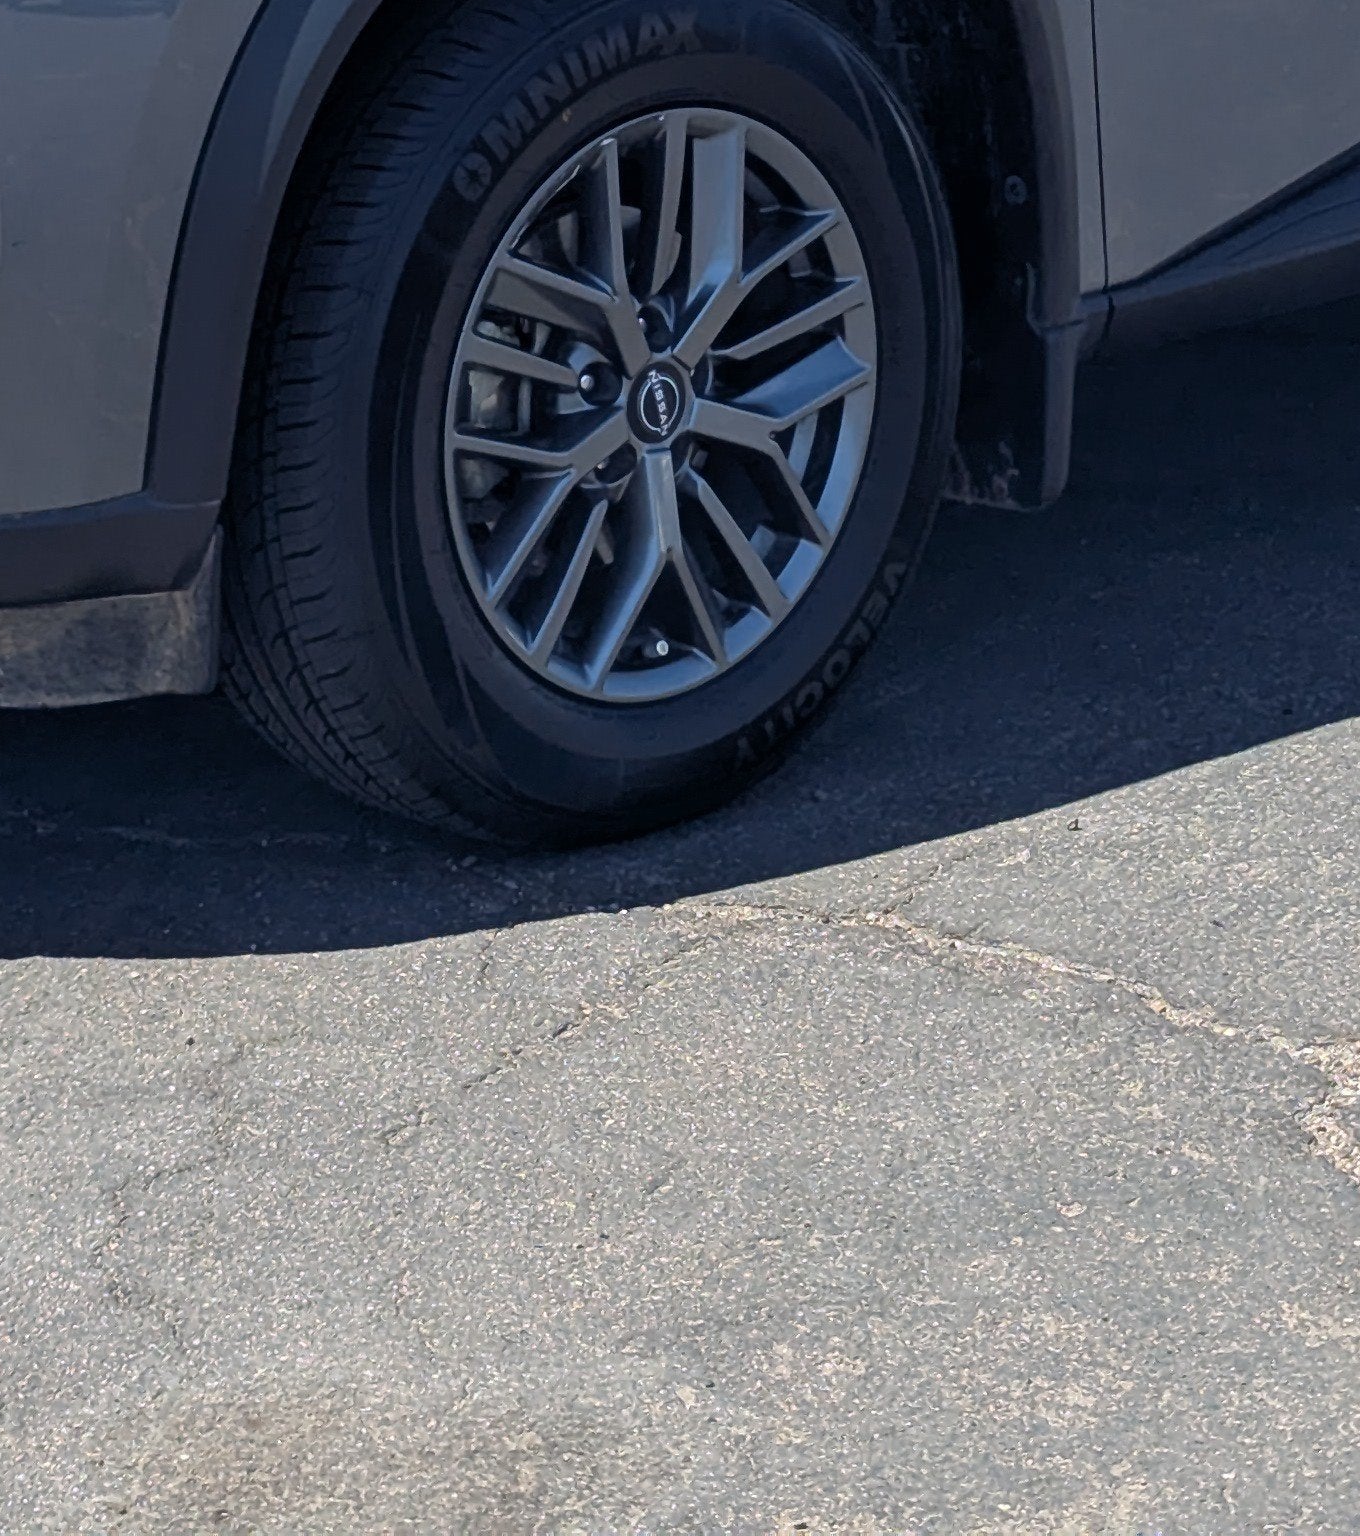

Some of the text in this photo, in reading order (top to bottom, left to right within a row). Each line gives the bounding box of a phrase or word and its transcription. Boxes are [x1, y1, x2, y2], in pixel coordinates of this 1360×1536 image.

[452, 9, 703, 203] OMNIMAX
[648, 368, 669, 437] NISSAN
[736, 559, 908, 769] VELOCITY
